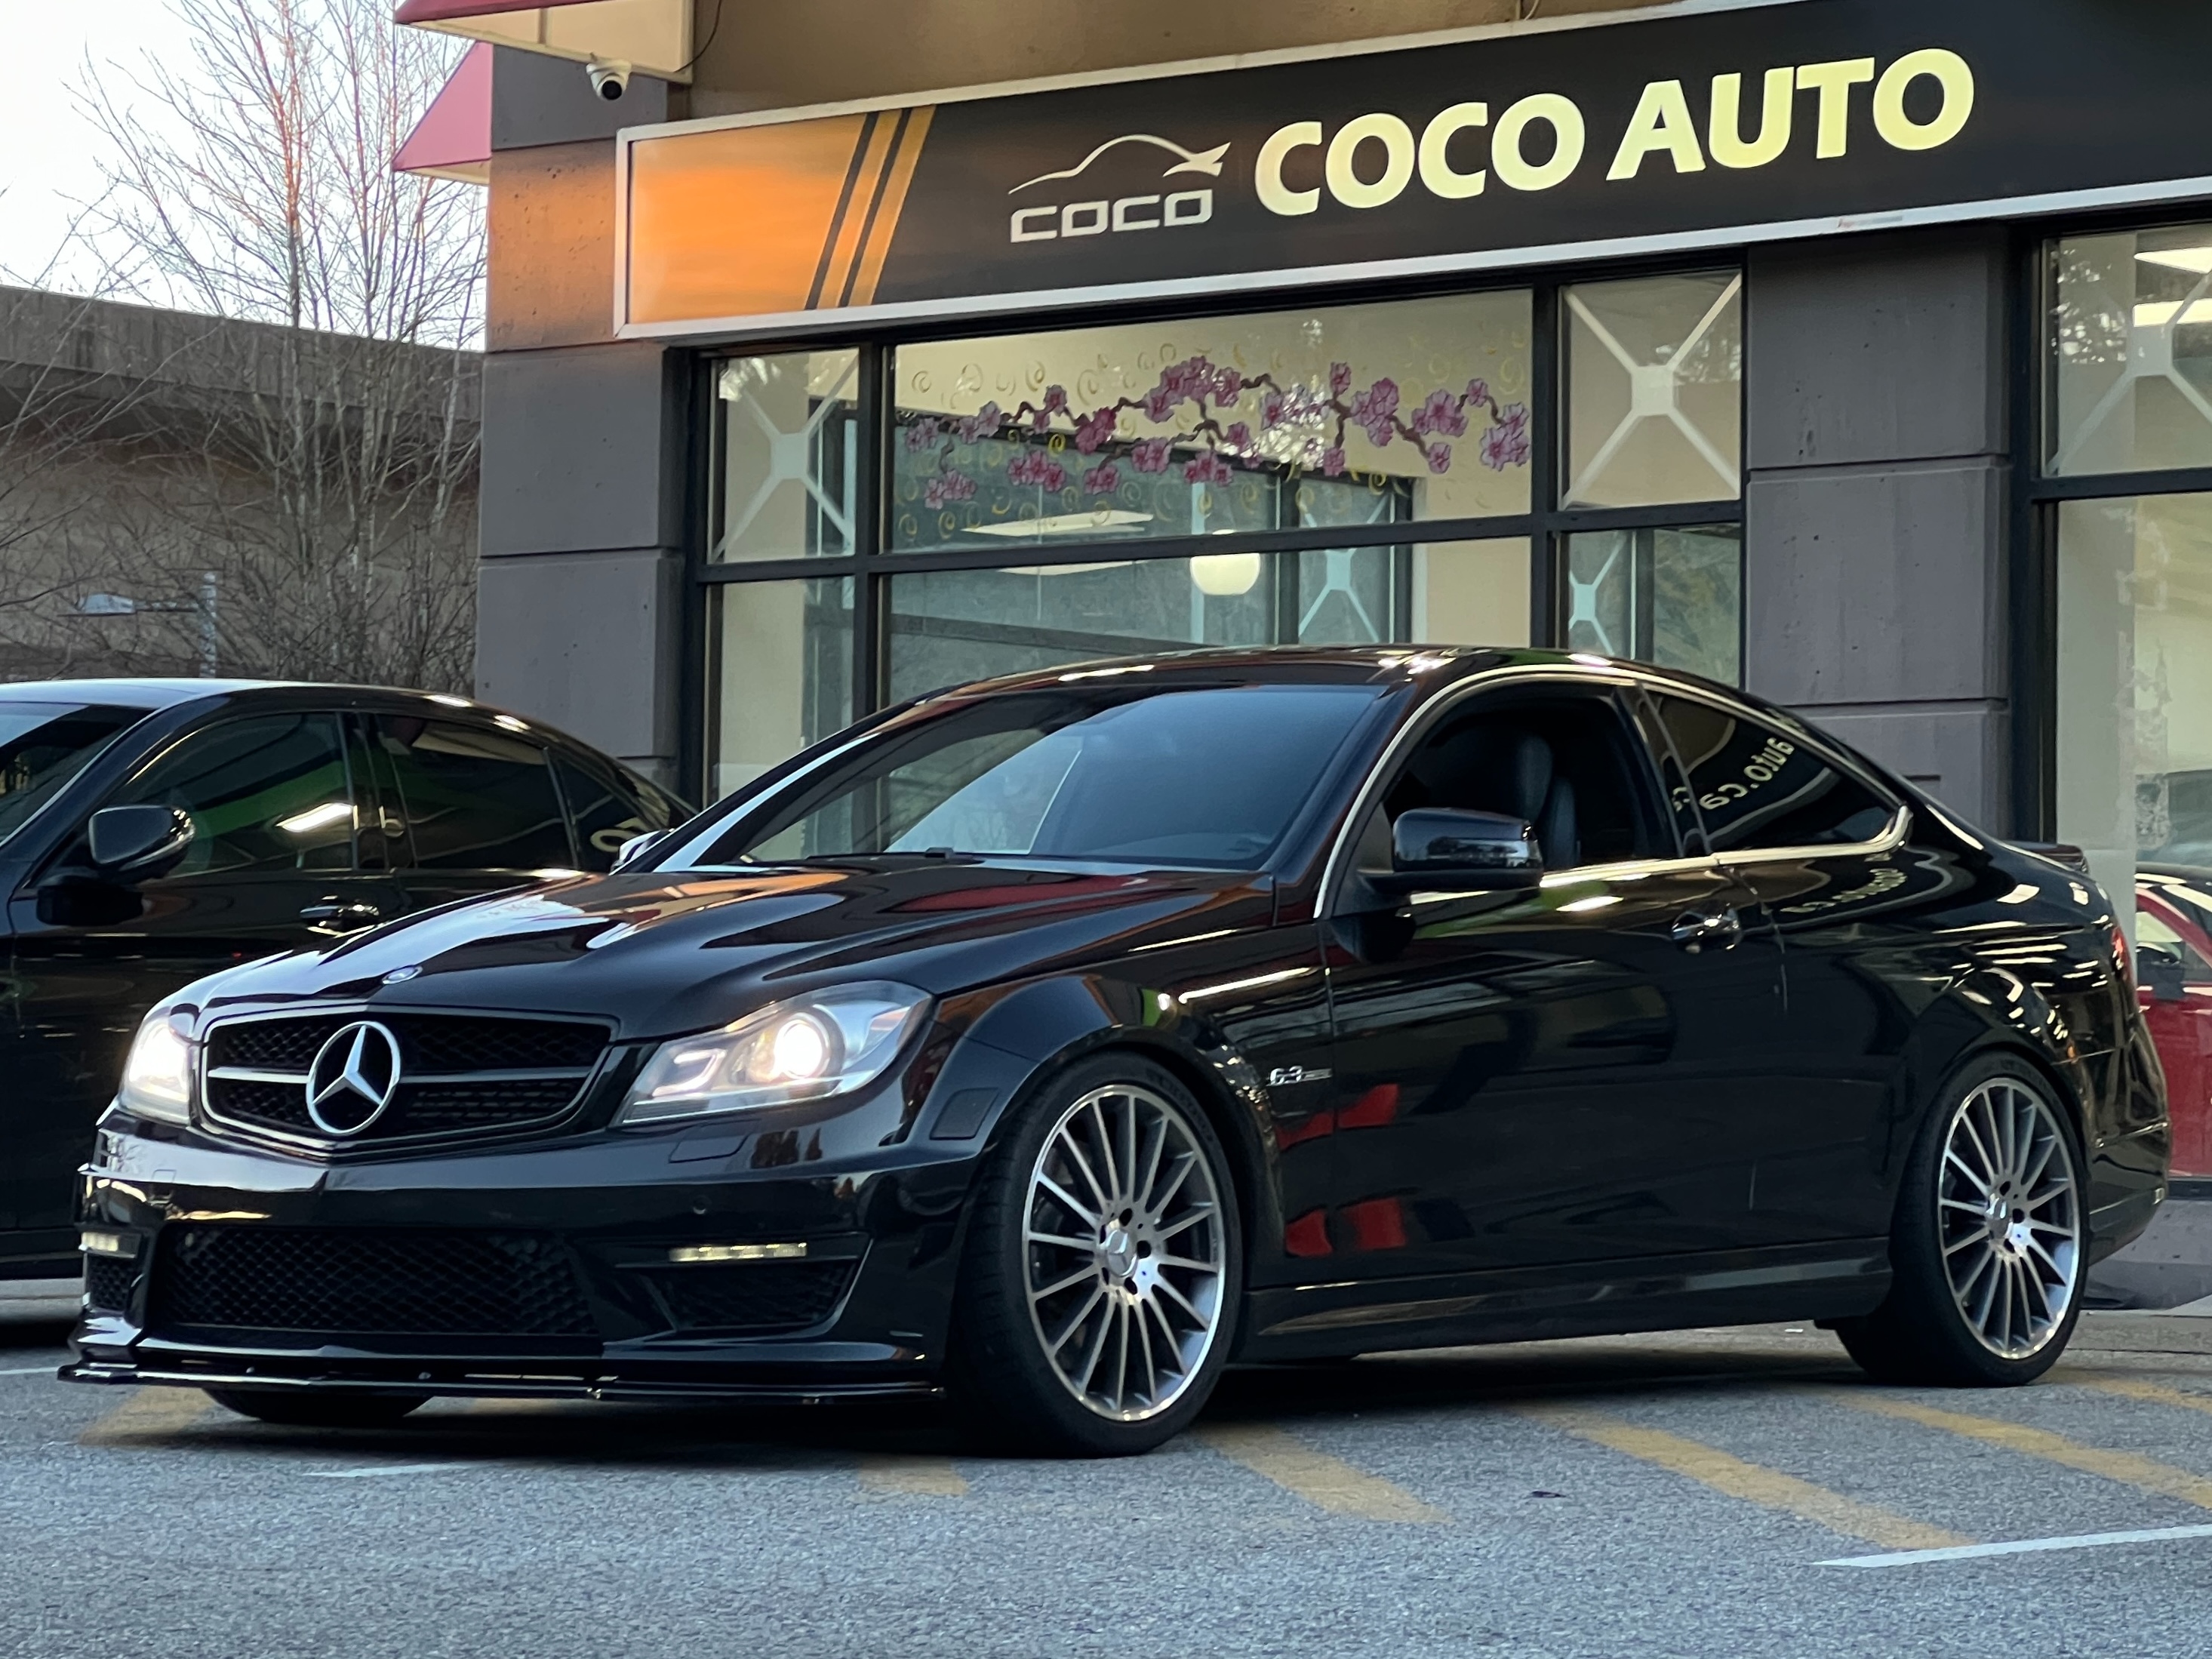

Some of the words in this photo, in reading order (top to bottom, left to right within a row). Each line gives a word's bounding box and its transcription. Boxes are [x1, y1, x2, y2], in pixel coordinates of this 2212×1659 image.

[1254, 93, 1586, 216] COCO
[1605, 48, 1974, 181] AUTO
[1010, 189, 1213, 243] COCO
